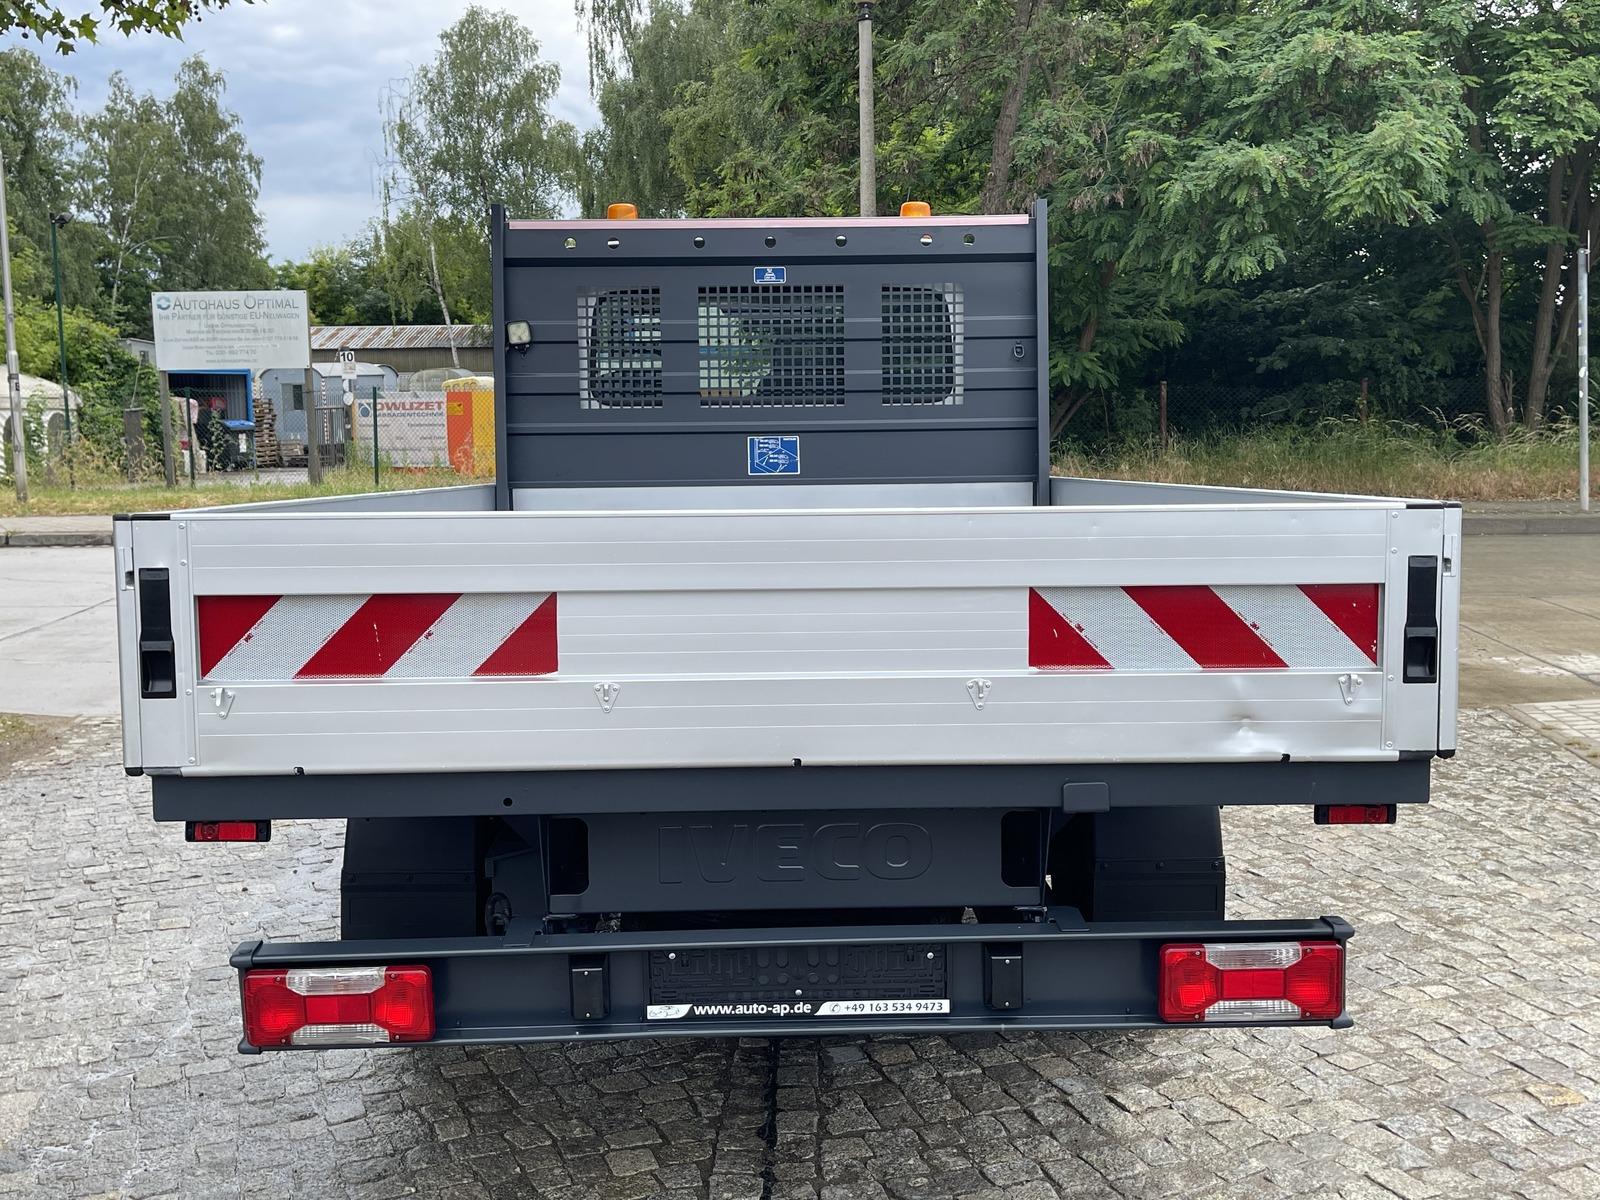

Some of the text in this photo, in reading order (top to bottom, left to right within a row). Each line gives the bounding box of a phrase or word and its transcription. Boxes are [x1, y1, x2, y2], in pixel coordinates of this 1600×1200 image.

[244, 295, 300, 310] OPTIMAL
[341, 352, 354, 362] 10
[659, 822, 933, 884] IVECO
[693, 1002, 812, 1017] www.auto-ap.de
[844, 1001, 943, 1014] +49 163 534 9473
